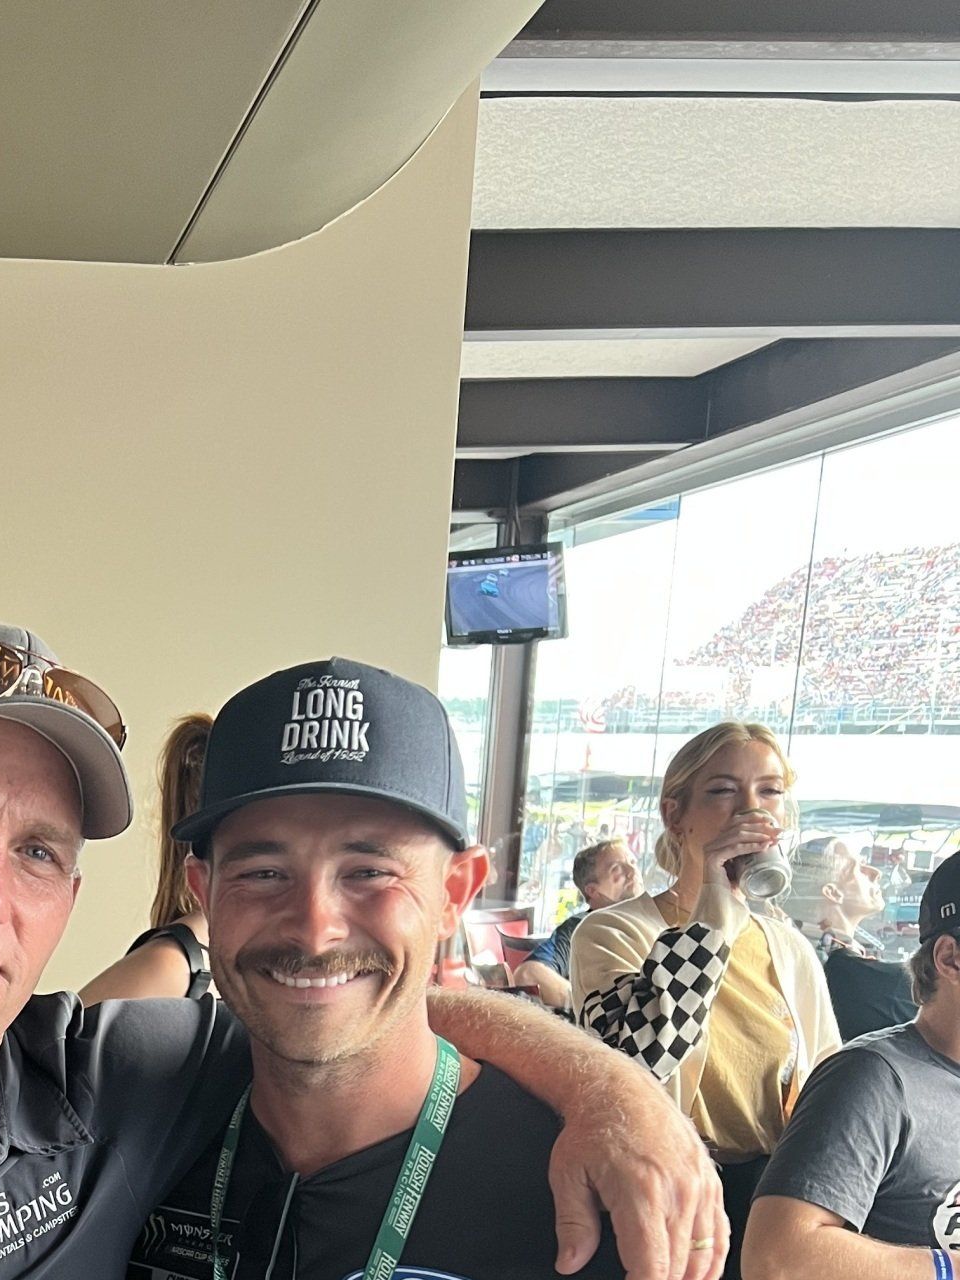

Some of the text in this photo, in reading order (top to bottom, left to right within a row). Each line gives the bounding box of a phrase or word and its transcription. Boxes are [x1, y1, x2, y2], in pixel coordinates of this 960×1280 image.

[291, 688, 364, 720] LONG
[281, 720, 370, 752] DRINK
[320, 749, 334, 763] of
[333, 750, 366, 762] 1952
[431, 1062, 446, 1101] RACING
[431, 1084, 456, 1133] FENWAY
[42, 1171, 61, 1188] .COM
[393, 1160, 414, 1206] RACING
[394, 1145, 436, 1237] ROUSH FENWAY
[25, 1233, 33, 1243] &
[33, 1205, 79, 1238] CAMPSITE
[171, 1222, 234, 1247] MONSER
